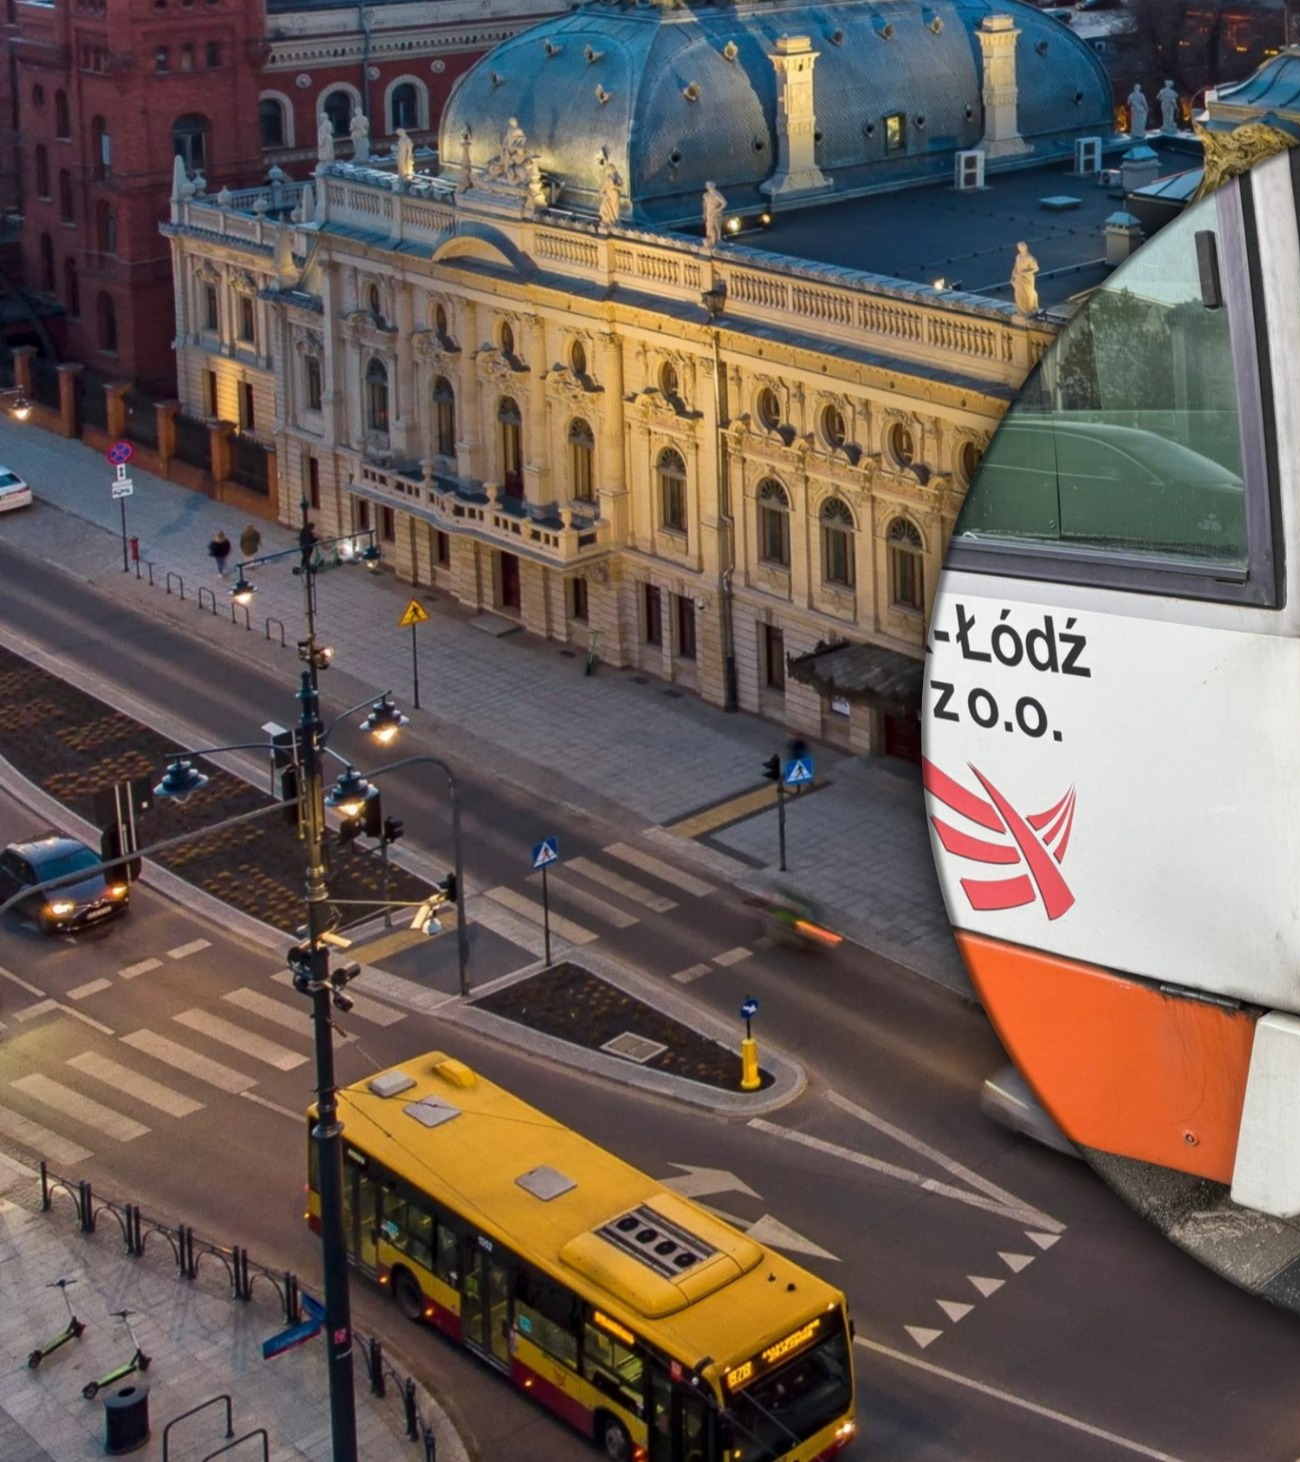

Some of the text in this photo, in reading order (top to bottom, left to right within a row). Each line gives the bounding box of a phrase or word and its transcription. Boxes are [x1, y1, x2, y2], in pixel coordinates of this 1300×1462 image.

[927, 604, 1091, 678] -Łódź
[930, 680, 1063, 742] z o.o.
